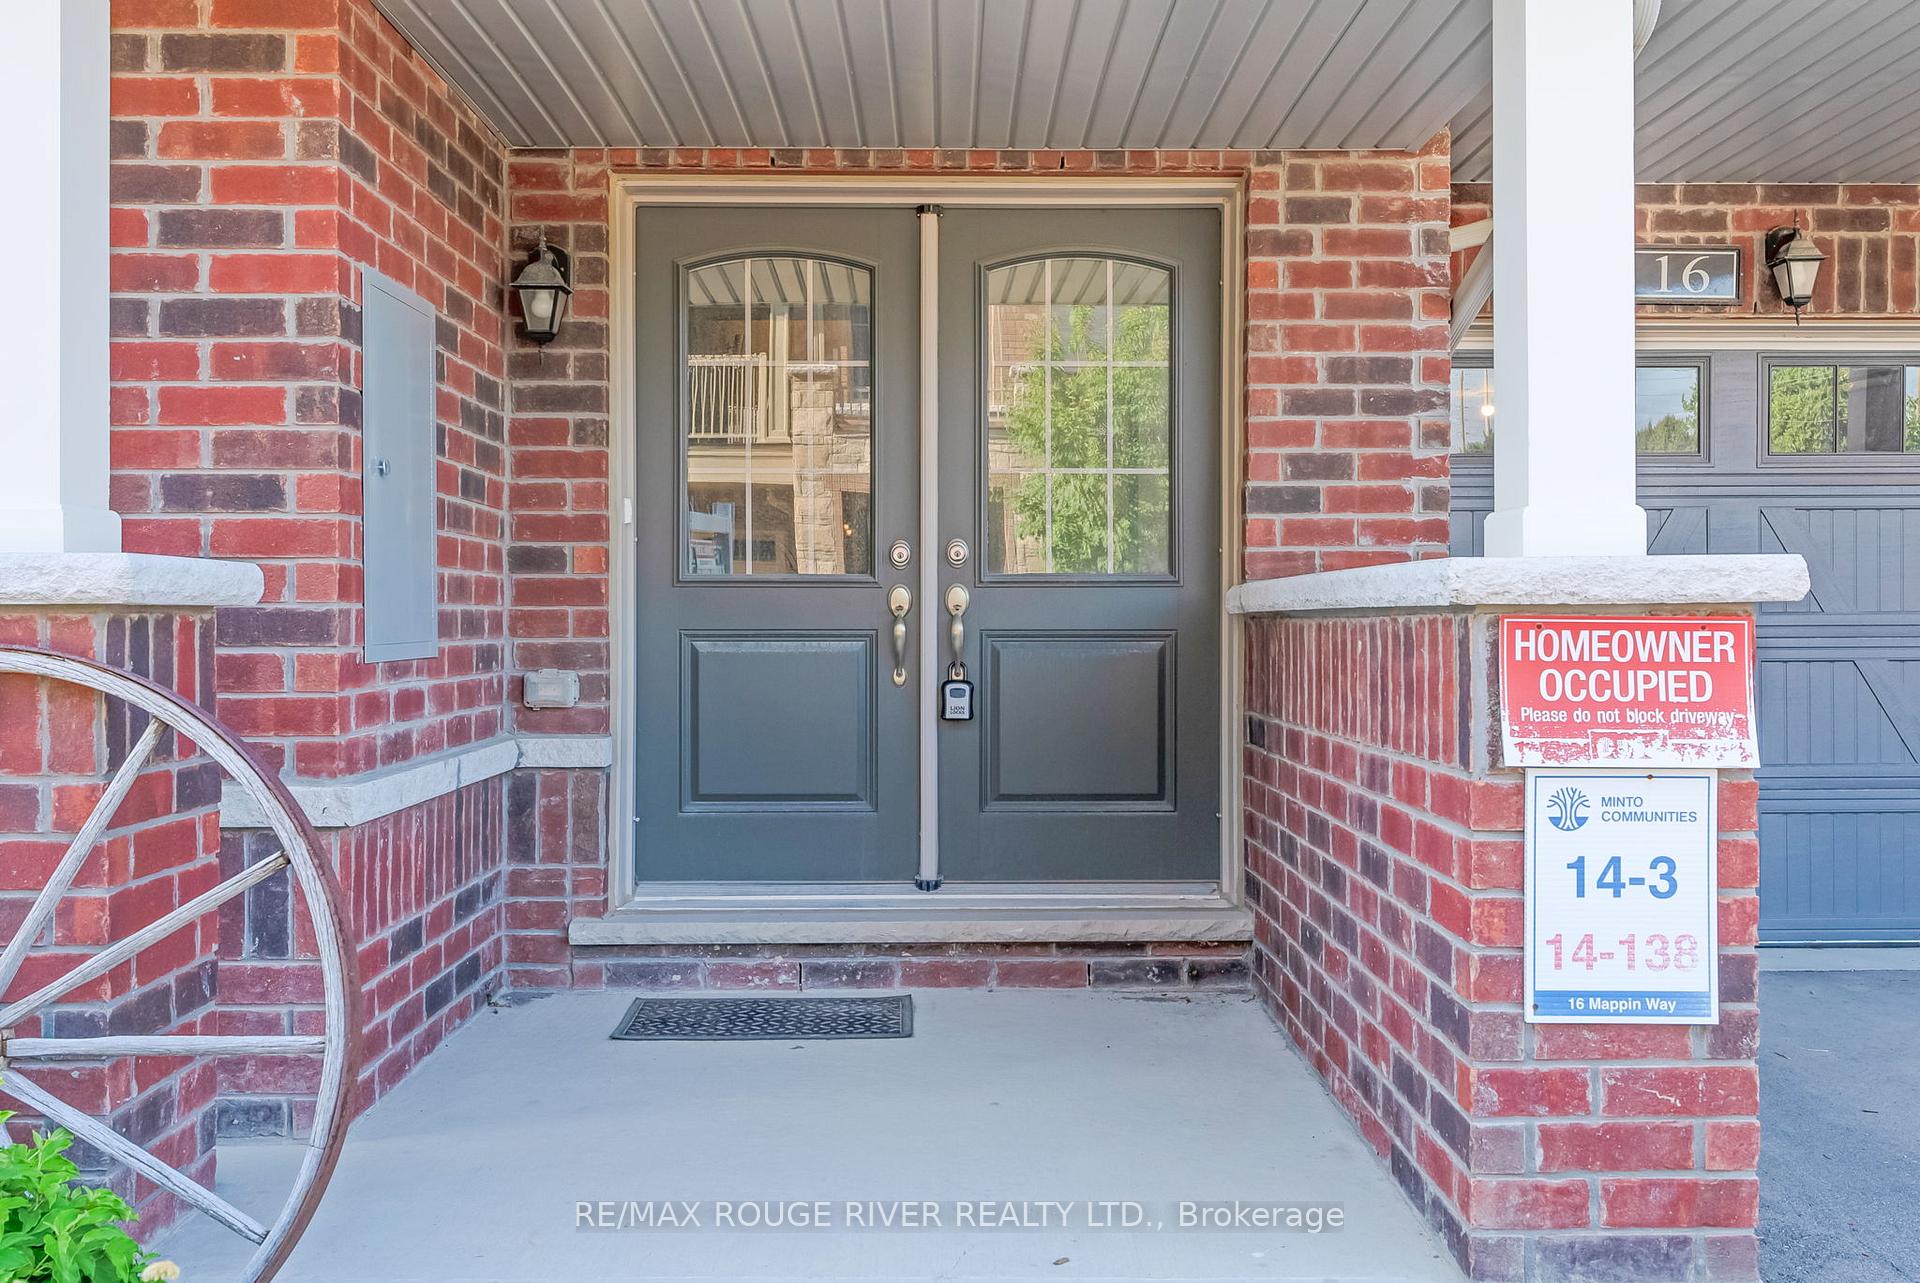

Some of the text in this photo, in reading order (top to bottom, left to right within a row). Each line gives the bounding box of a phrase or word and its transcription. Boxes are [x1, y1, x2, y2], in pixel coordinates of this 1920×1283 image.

[1655, 255, 1710, 293] 16
[1514, 629, 1736, 663] HOMEOWNER
[1539, 669, 1713, 703] OCCUPIED
[1520, 707, 1735, 726] Please do not block driveway
[1601, 796, 1644, 808] MINTO
[1601, 811, 1698, 823] COMMUNITIES
[1566, 855, 1678, 900] 14-3
[1546, 933, 1698, 972] 14-138
[1568, 997, 1676, 1013] 16 Mappin Way
